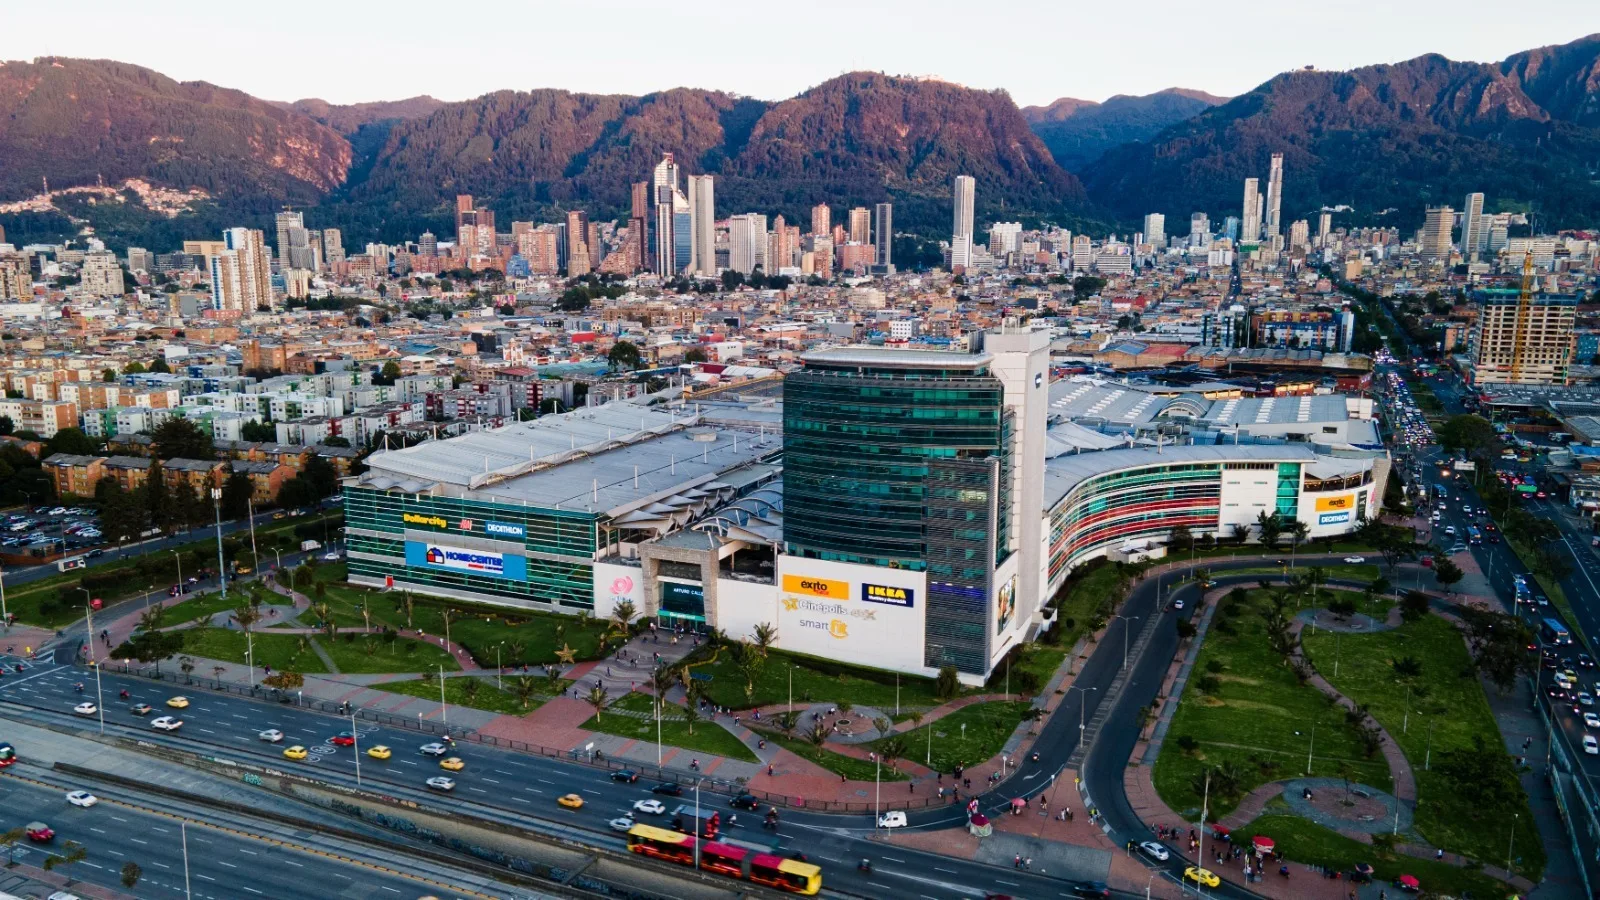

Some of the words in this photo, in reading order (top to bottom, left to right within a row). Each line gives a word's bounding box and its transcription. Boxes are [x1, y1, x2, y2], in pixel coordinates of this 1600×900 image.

[403, 513, 447, 528] Dollarcity
[487, 523, 523, 535] DECATHLON
[446, 551, 503, 566] HOMECENTER
[868, 585, 906, 599] IKEA
[799, 600, 848, 615] Cinépolis
[800, 619, 829, 630] smart
